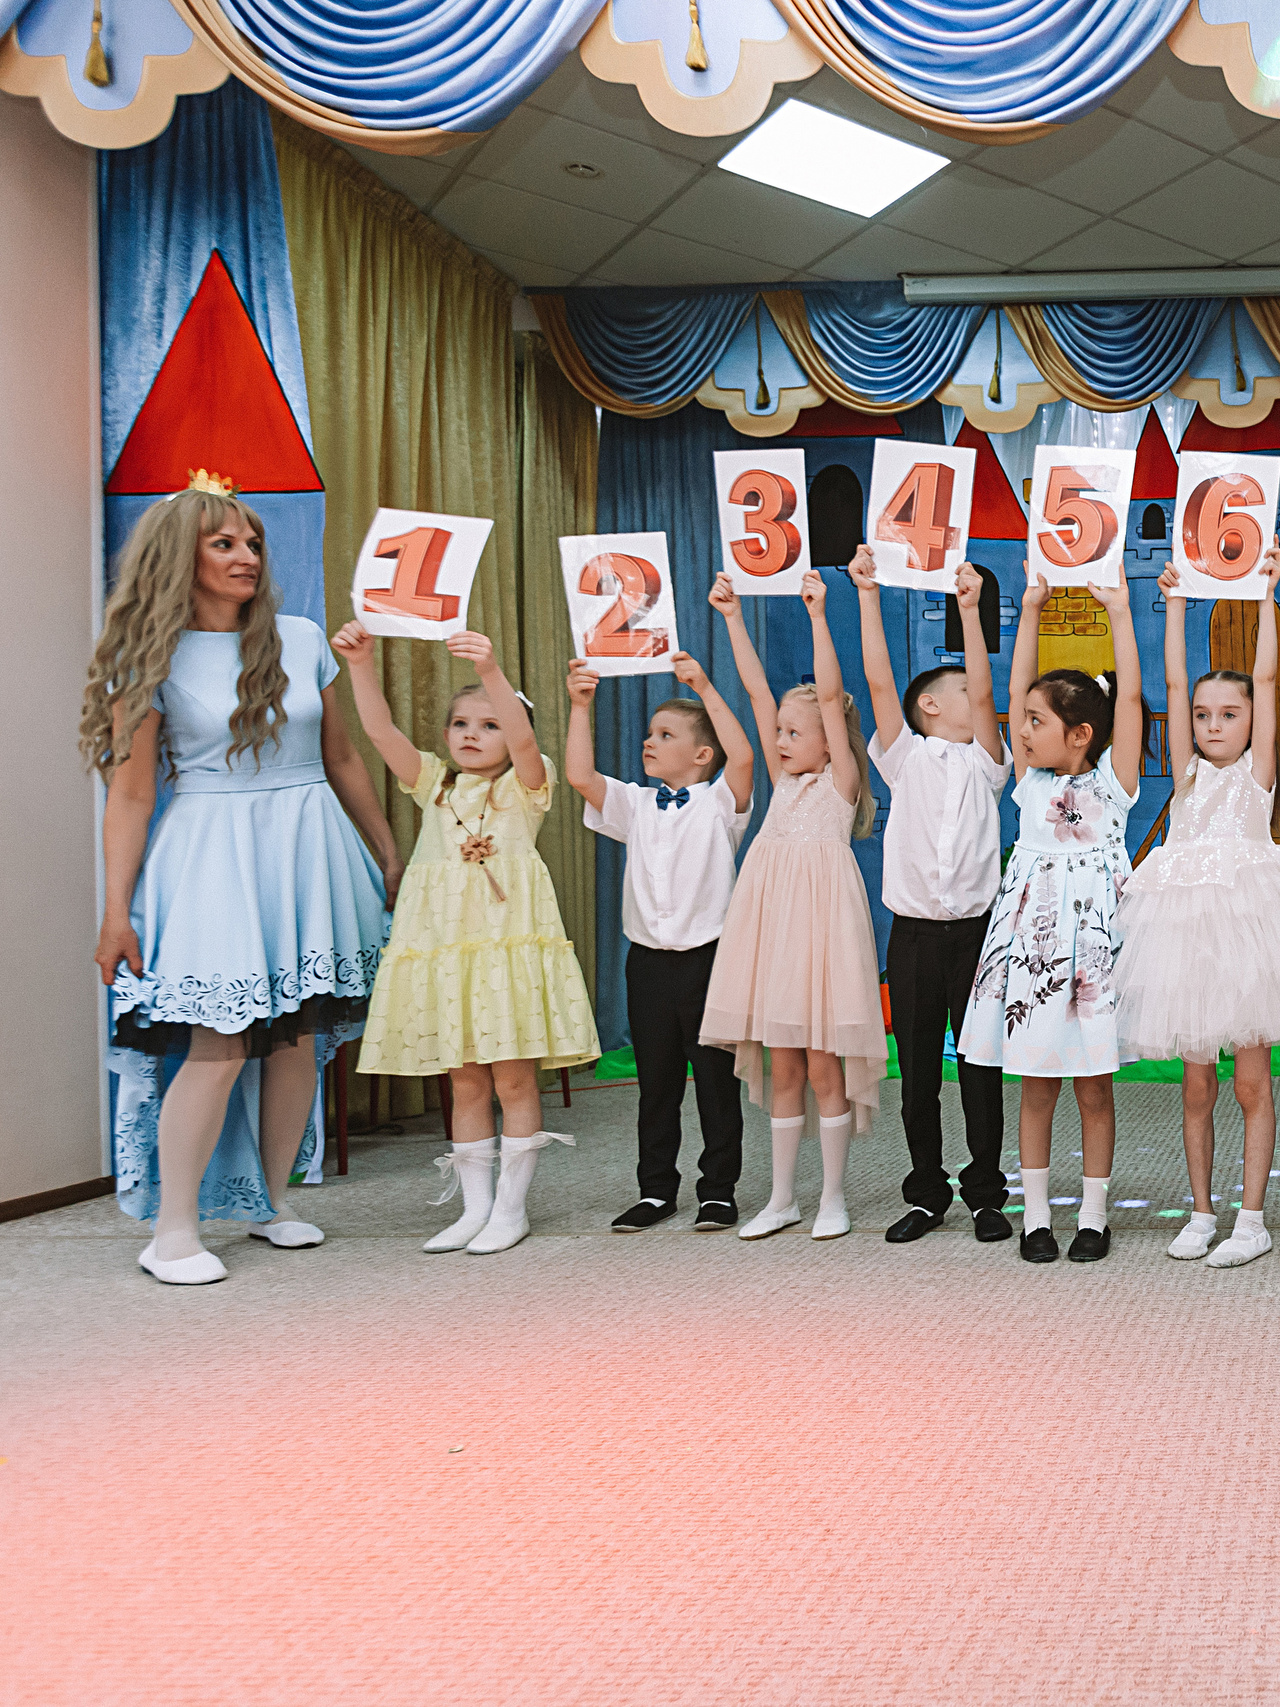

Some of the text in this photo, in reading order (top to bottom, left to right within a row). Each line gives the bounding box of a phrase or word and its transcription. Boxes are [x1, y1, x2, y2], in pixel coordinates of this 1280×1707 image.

[728, 469, 801, 577] 3
[876, 462, 961, 572] 4
[1037, 465, 1119, 567] 5
[1183, 472, 1266, 582] 6
[364, 527, 461, 621] 1
[578, 552, 669, 658] 2
